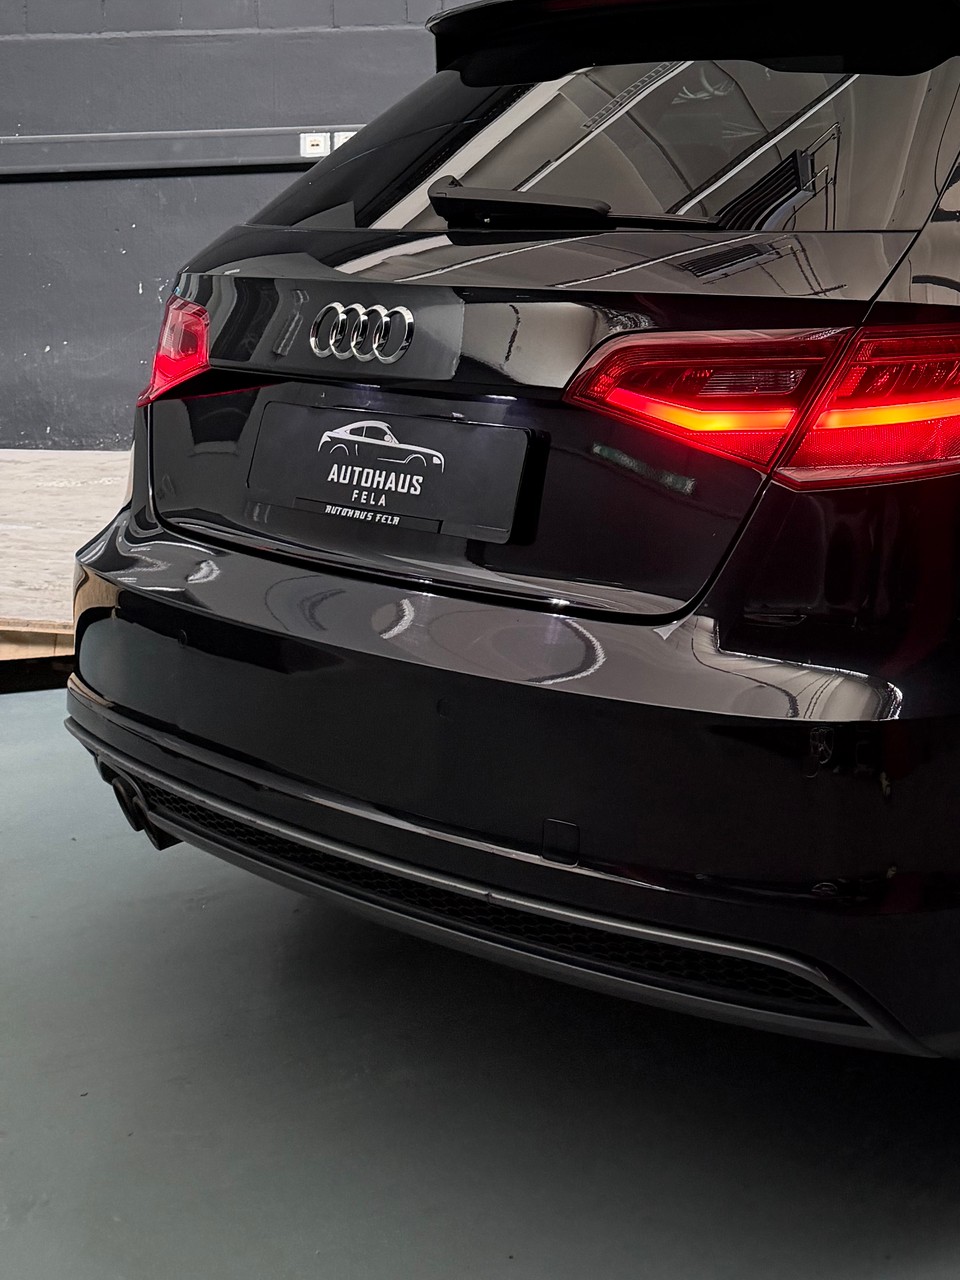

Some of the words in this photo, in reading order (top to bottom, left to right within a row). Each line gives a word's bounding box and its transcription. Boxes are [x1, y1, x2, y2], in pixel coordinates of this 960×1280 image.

[327, 463, 424, 495] AUTOHAUS
[351, 489, 387, 507] FELA
[325, 505, 373, 520] AUTOHAUS
[375, 514, 400, 525] FELA
